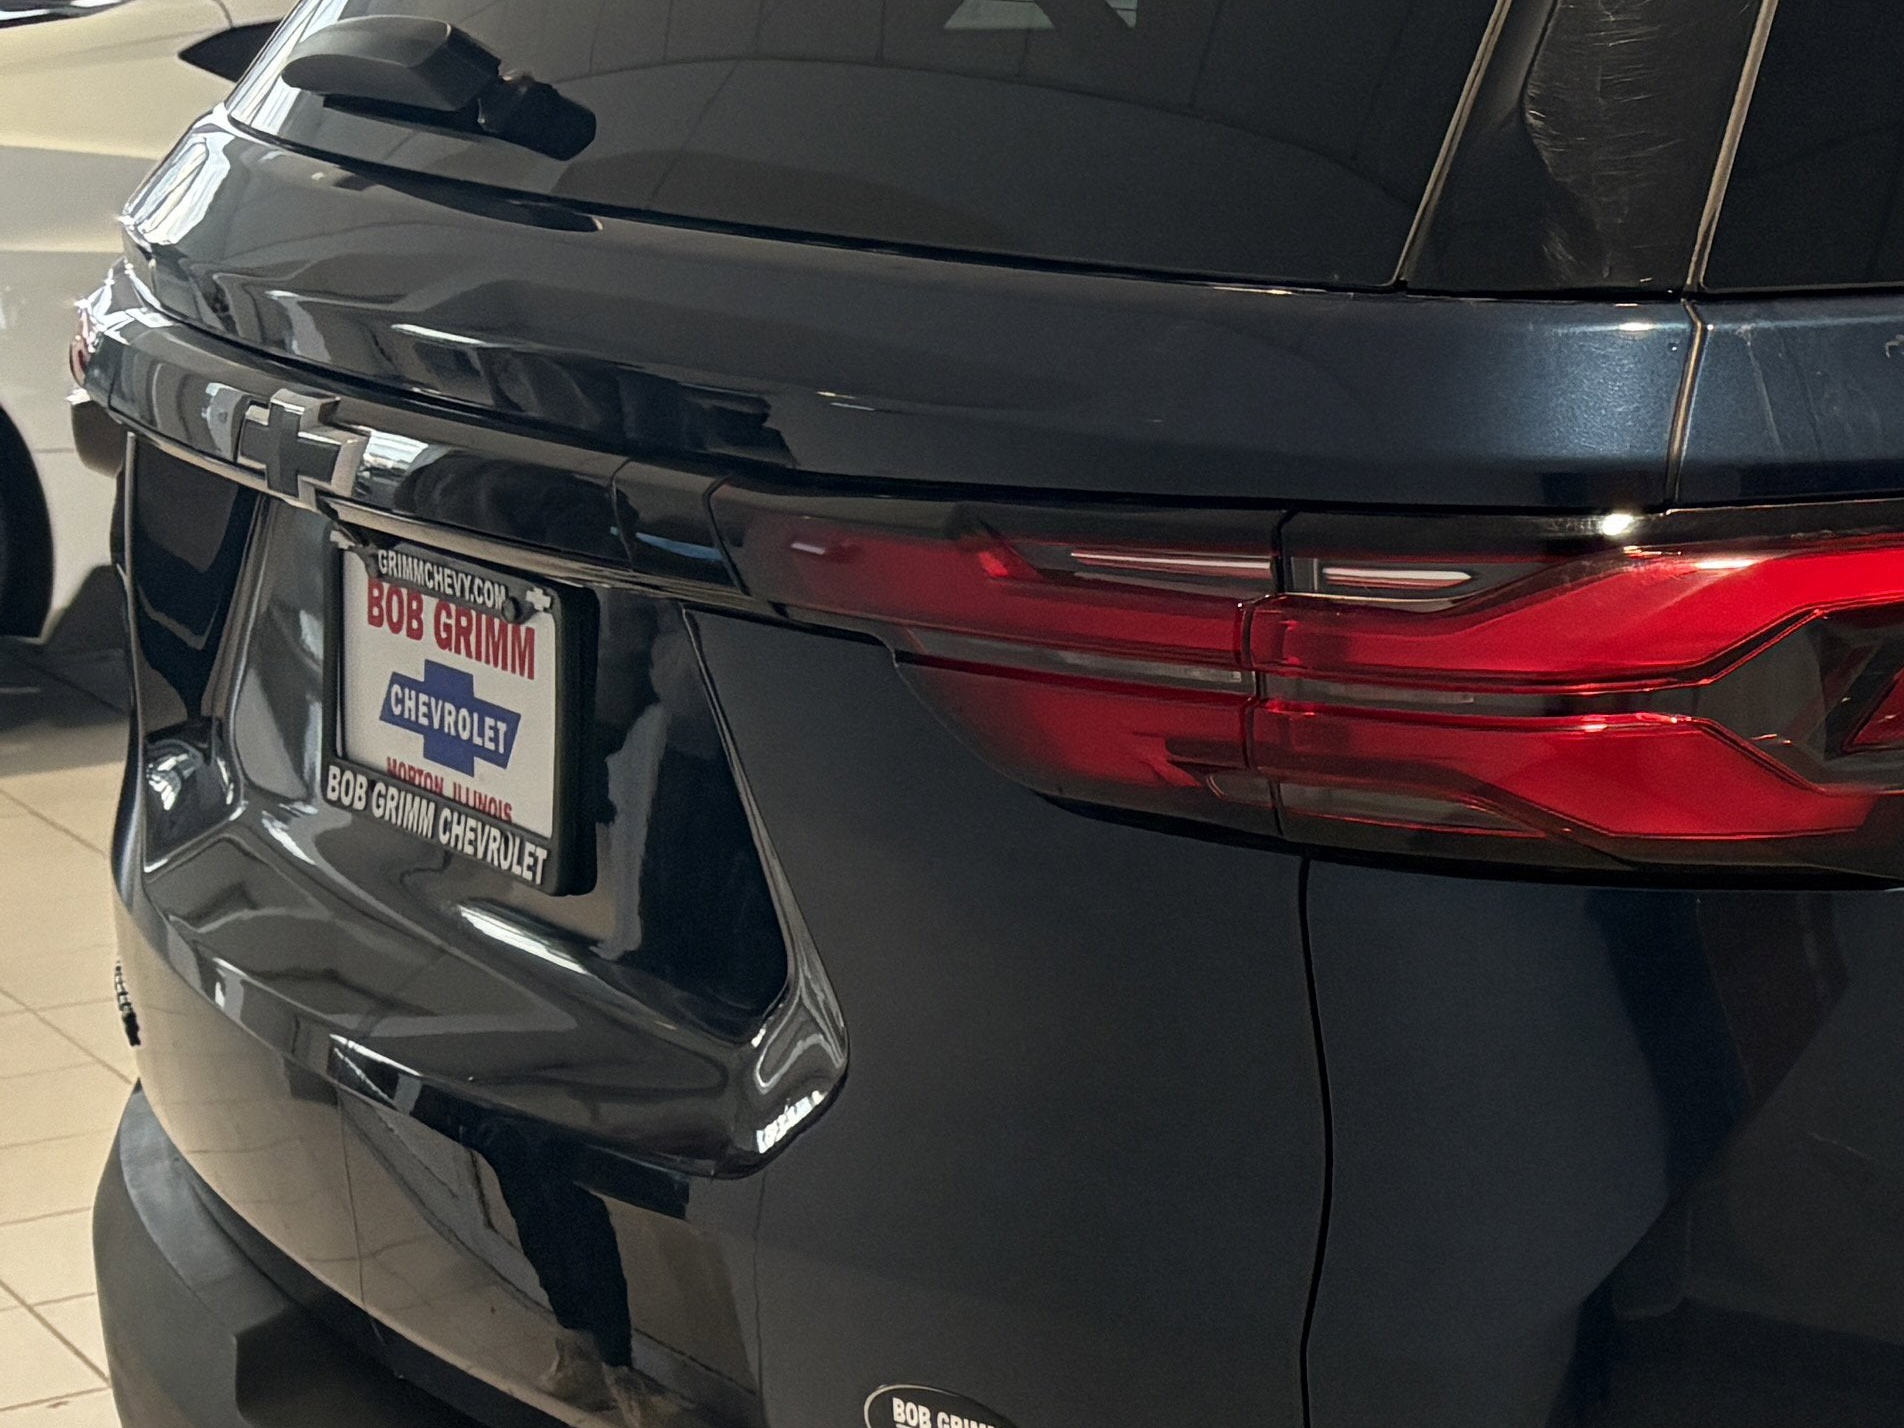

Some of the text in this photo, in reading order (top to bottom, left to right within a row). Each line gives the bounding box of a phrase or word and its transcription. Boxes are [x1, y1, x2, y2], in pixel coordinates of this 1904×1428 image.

[377, 548, 507, 610] GRIMMCHEVY.COM
[367, 577, 536, 681] BOB GRIMM
[389, 683, 508, 755] CHEVROLET
[326, 765, 548, 885] BOB GRIMM CHEVROLET
[453, 781, 513, 822] ILLINOIS
